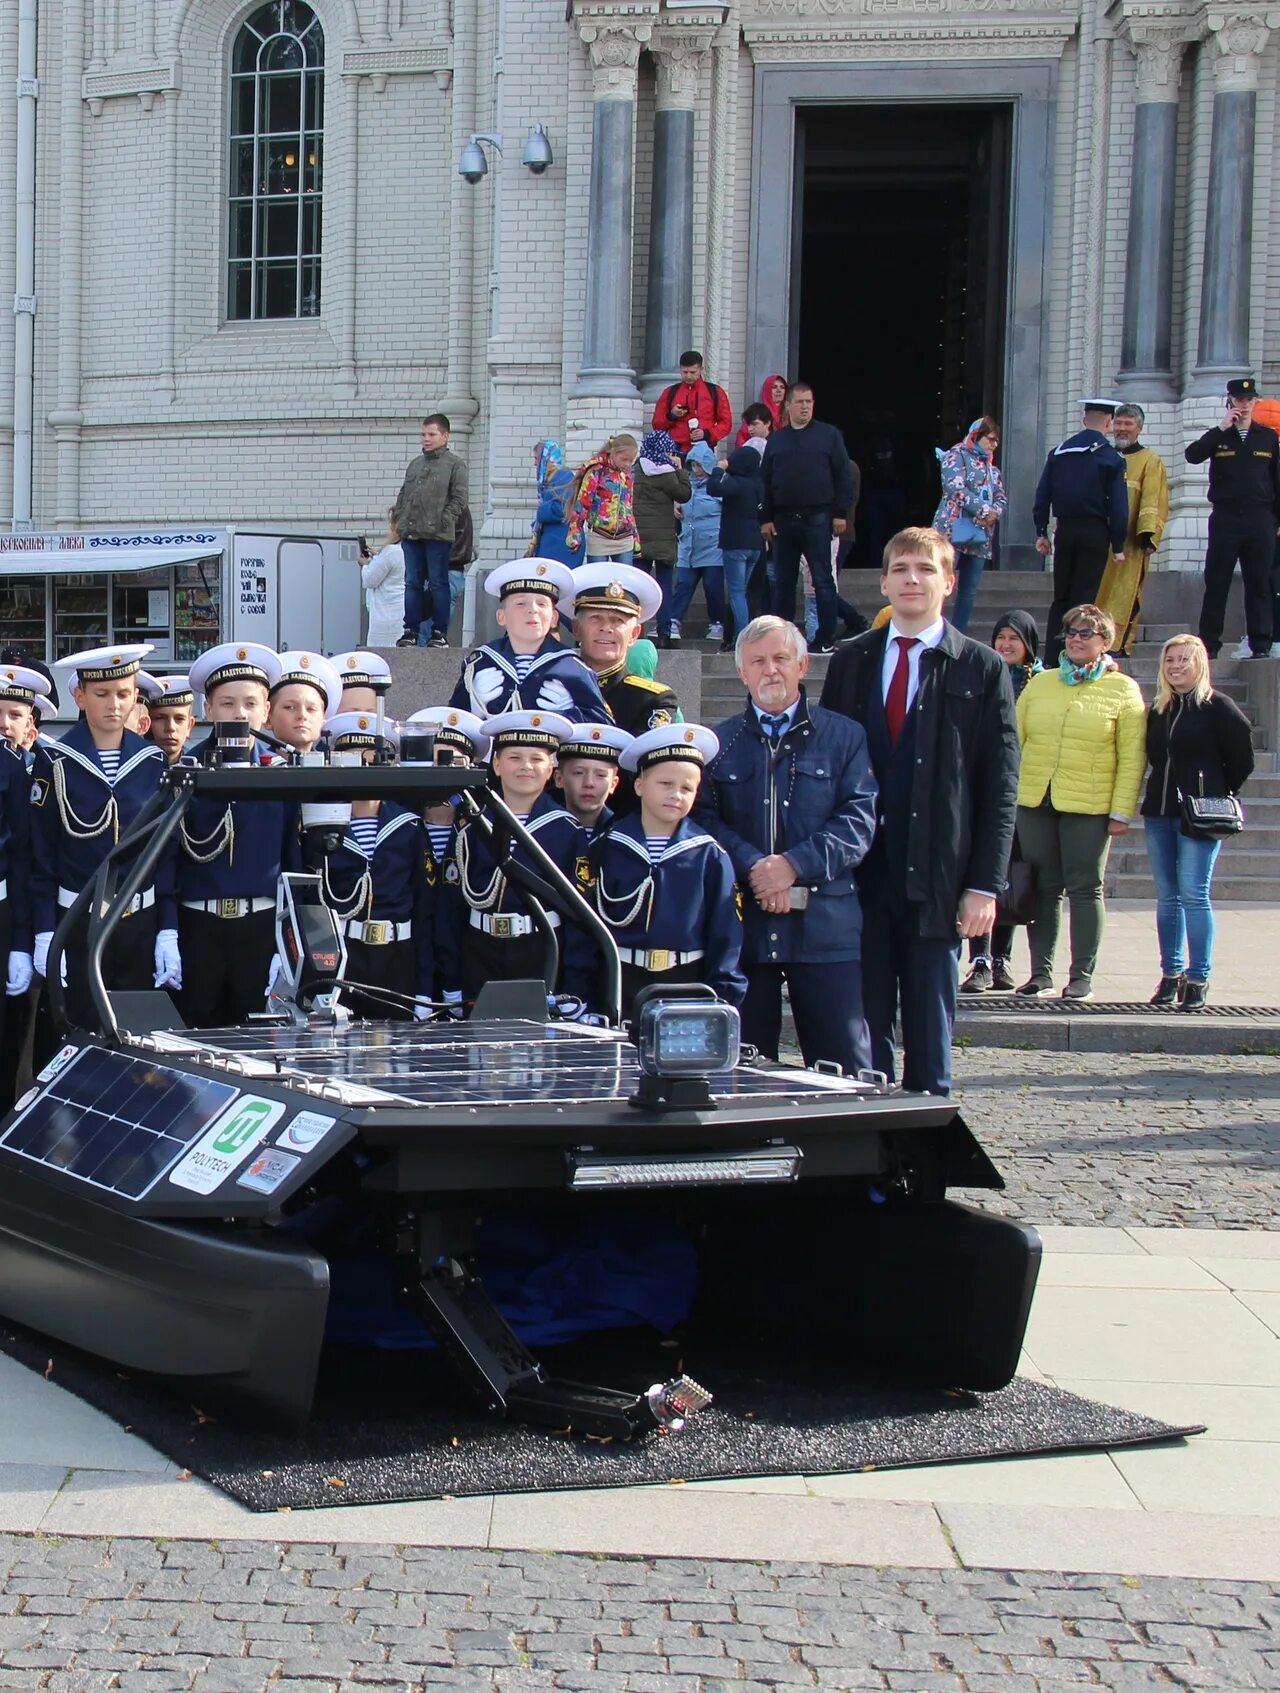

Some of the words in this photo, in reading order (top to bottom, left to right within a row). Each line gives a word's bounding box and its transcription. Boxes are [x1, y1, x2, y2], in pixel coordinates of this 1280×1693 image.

[350, 734, 375, 745] КАДЕТСК
[312, 952, 336, 960] CRUISE
[190, 1151, 232, 1174] POLYTECH
